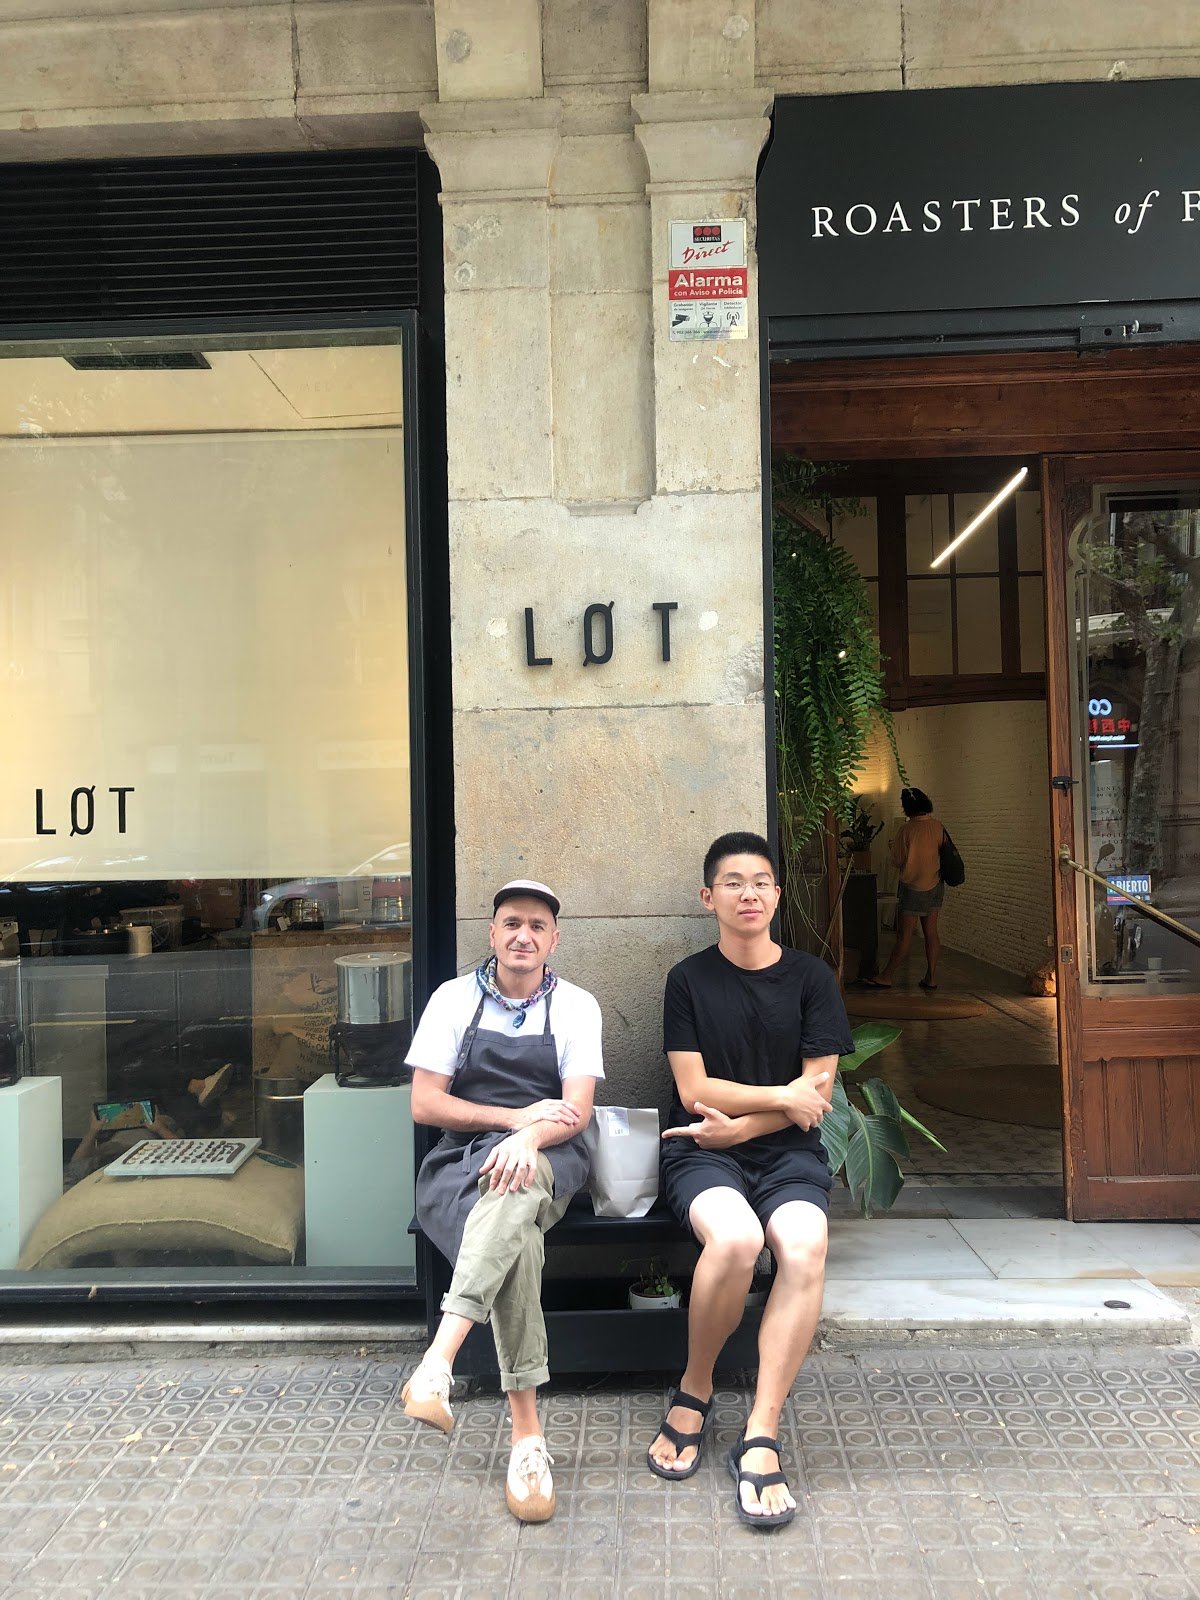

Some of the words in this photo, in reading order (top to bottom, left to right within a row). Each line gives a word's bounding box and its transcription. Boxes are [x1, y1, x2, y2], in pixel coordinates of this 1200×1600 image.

[811, 194, 1080, 237] ROASTERS
[1114, 190, 1159, 234] of
[682, 240, 735, 264] Direct
[674, 272, 743, 288] Alarma
[718, 287, 743, 295] Policía
[525, 601, 678, 666] LØT
[36, 785, 135, 837] LØT
